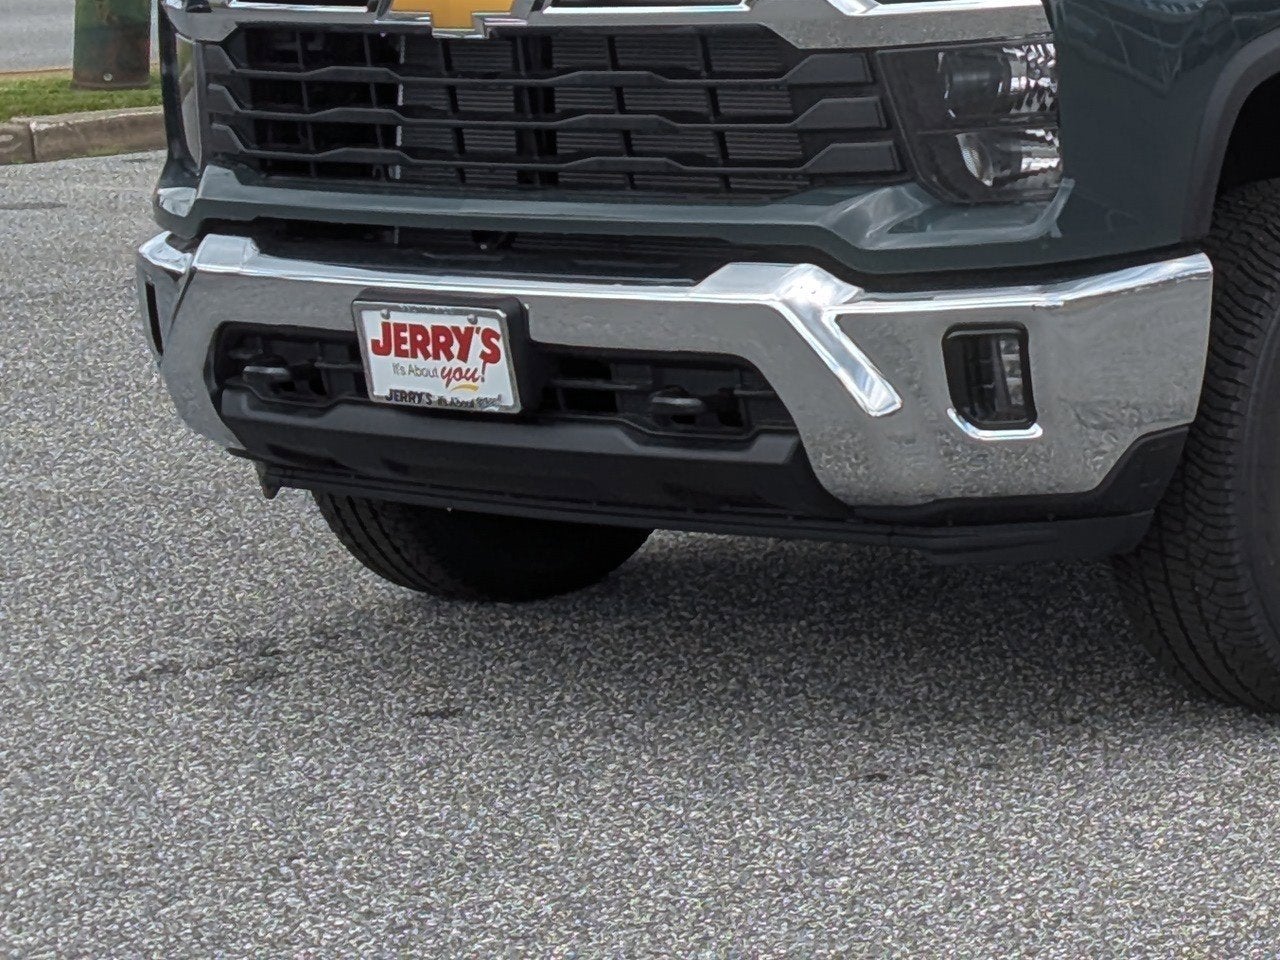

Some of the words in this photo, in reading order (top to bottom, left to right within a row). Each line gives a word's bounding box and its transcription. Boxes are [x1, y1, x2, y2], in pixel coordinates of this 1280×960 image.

[371, 321, 502, 365] JERRY'S
[408, 364, 439, 378] About
[441, 360, 486, 388] you!
[385, 388, 433, 406] JERRY'S
